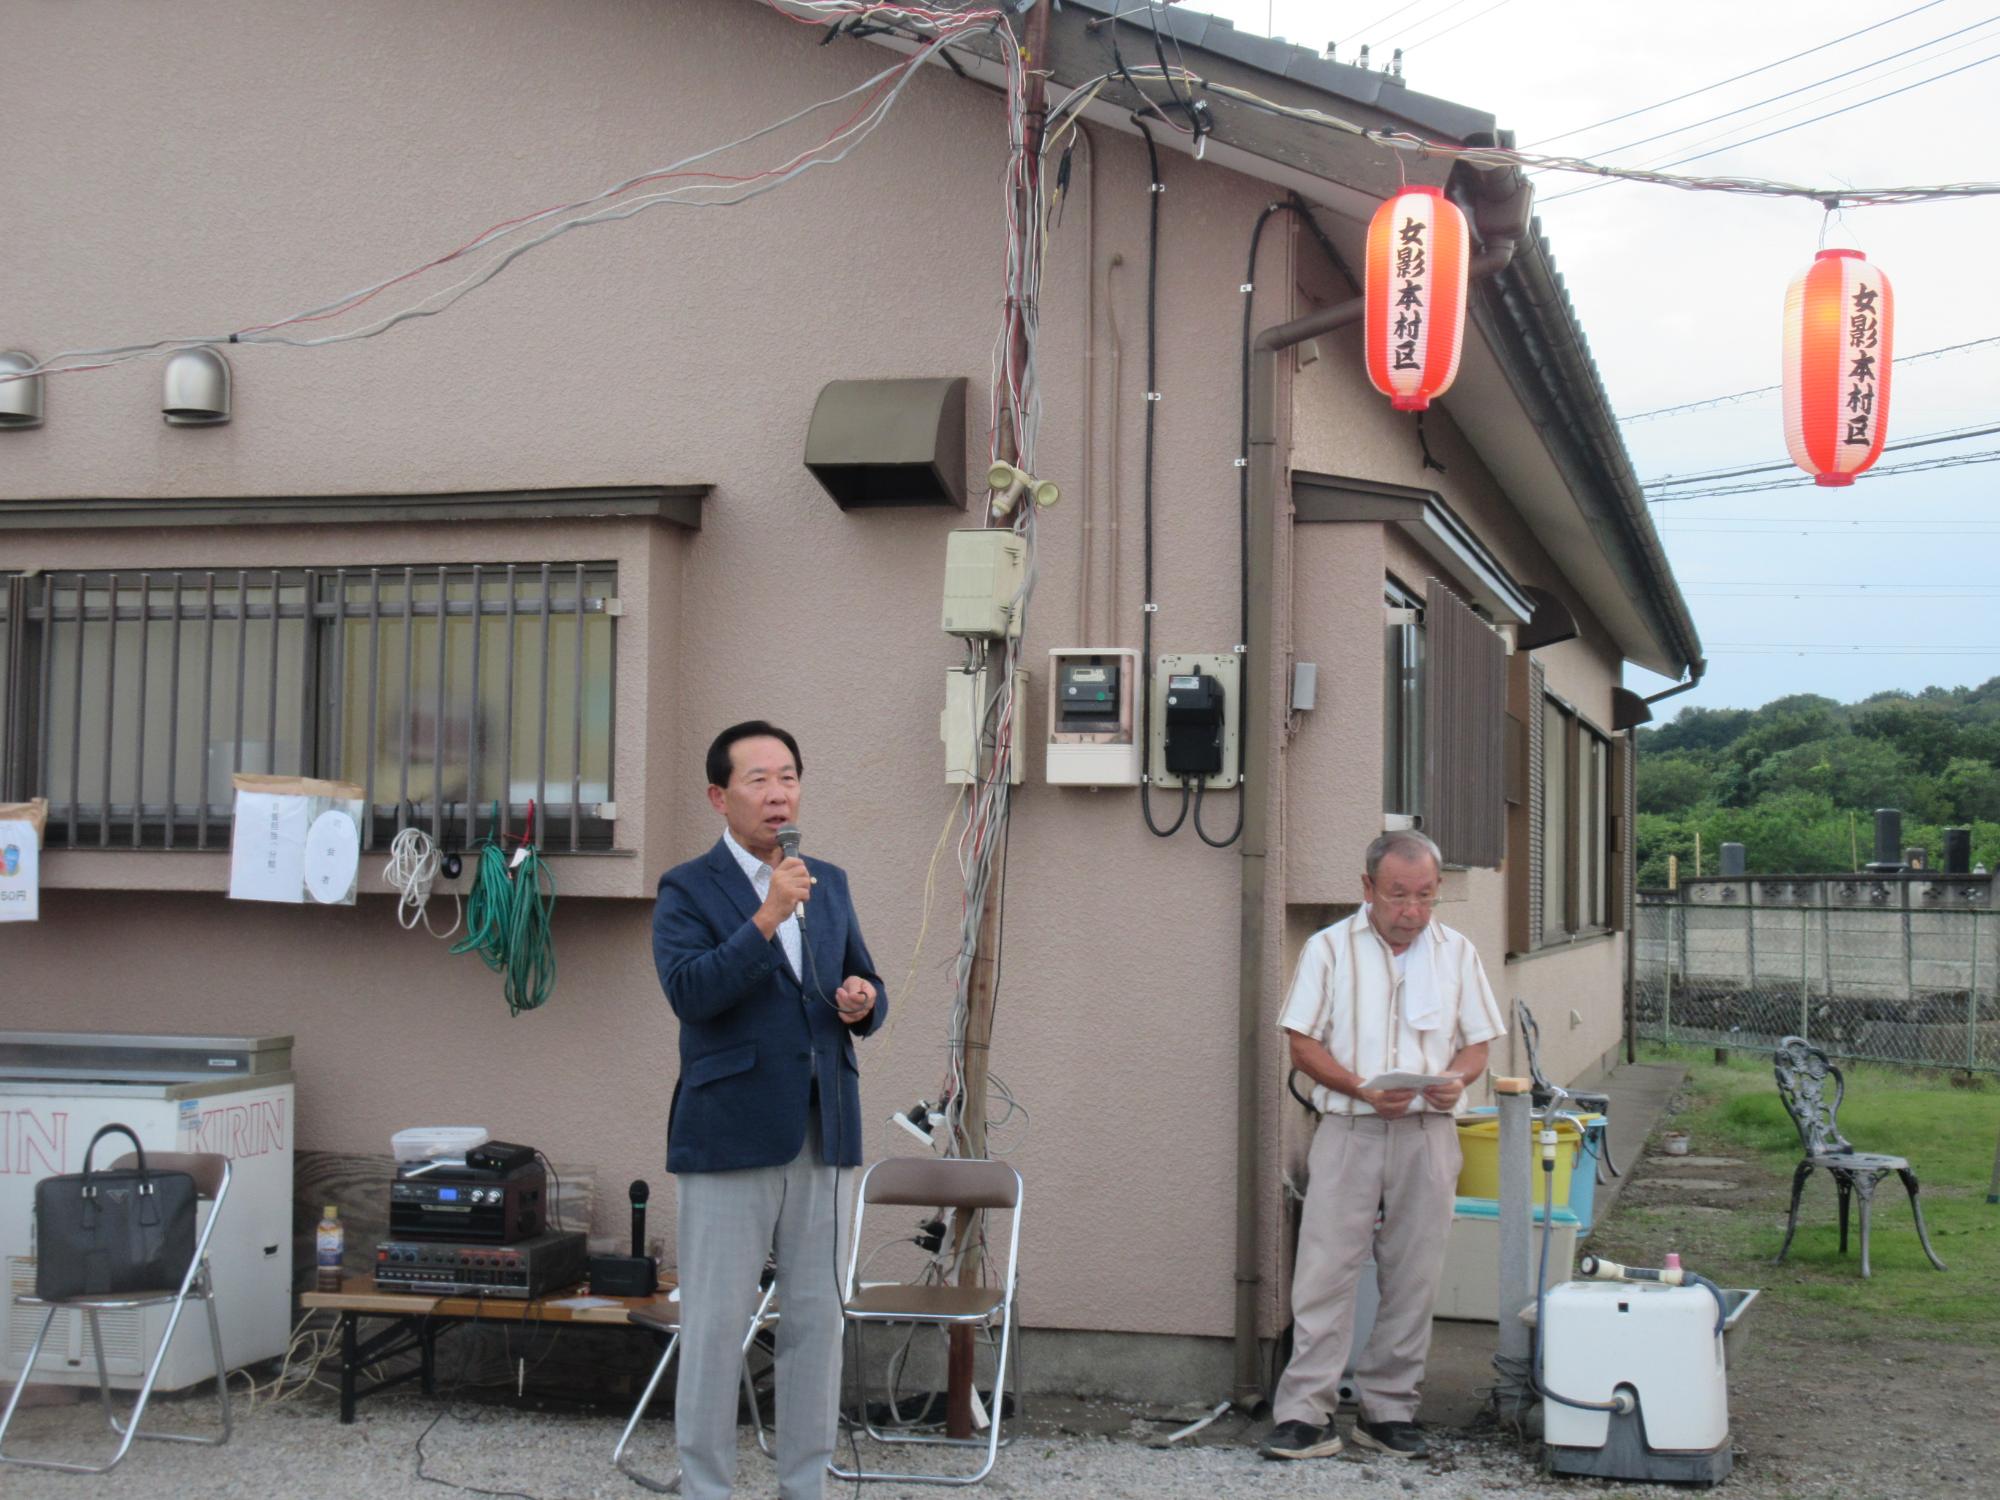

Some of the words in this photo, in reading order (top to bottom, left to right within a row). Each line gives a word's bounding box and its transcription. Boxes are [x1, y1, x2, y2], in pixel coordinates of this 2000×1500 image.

[1392, 216, 1426, 371] 女影本村区
[1842, 282, 1879, 447] 女影本村区
[189, 1098, 285, 1160] KIRIN
